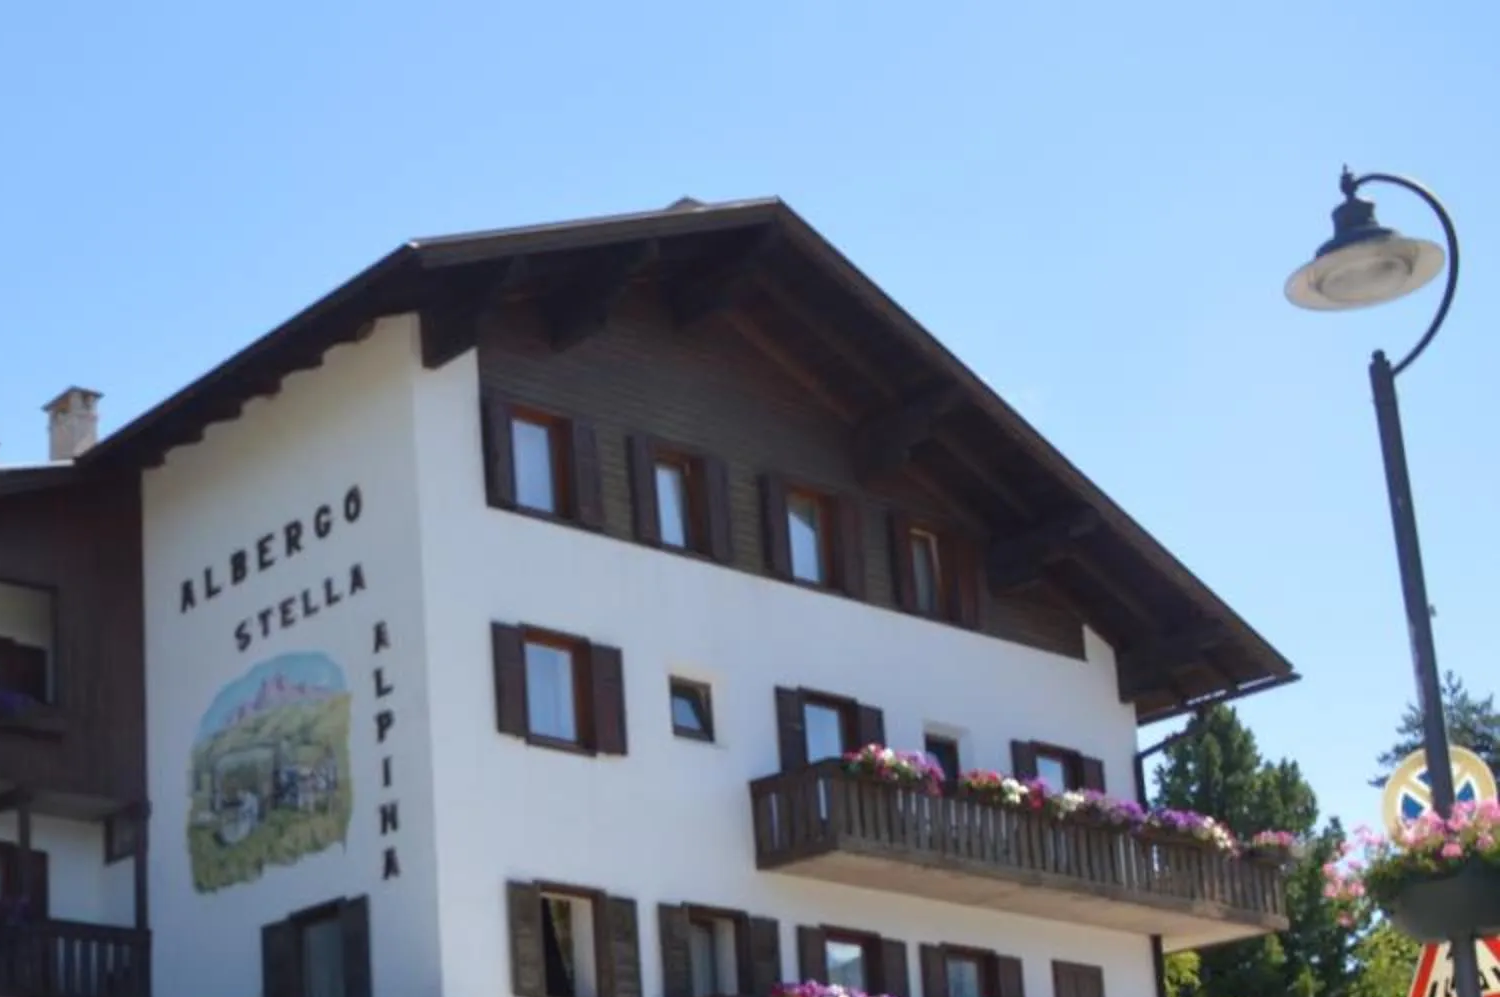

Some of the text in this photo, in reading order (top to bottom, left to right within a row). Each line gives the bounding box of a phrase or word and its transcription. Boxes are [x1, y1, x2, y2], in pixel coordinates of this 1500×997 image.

[180, 486, 362, 614] ALBERGO
[234, 564, 367, 652] STELLA
[373, 621, 400, 880] ALPINA
